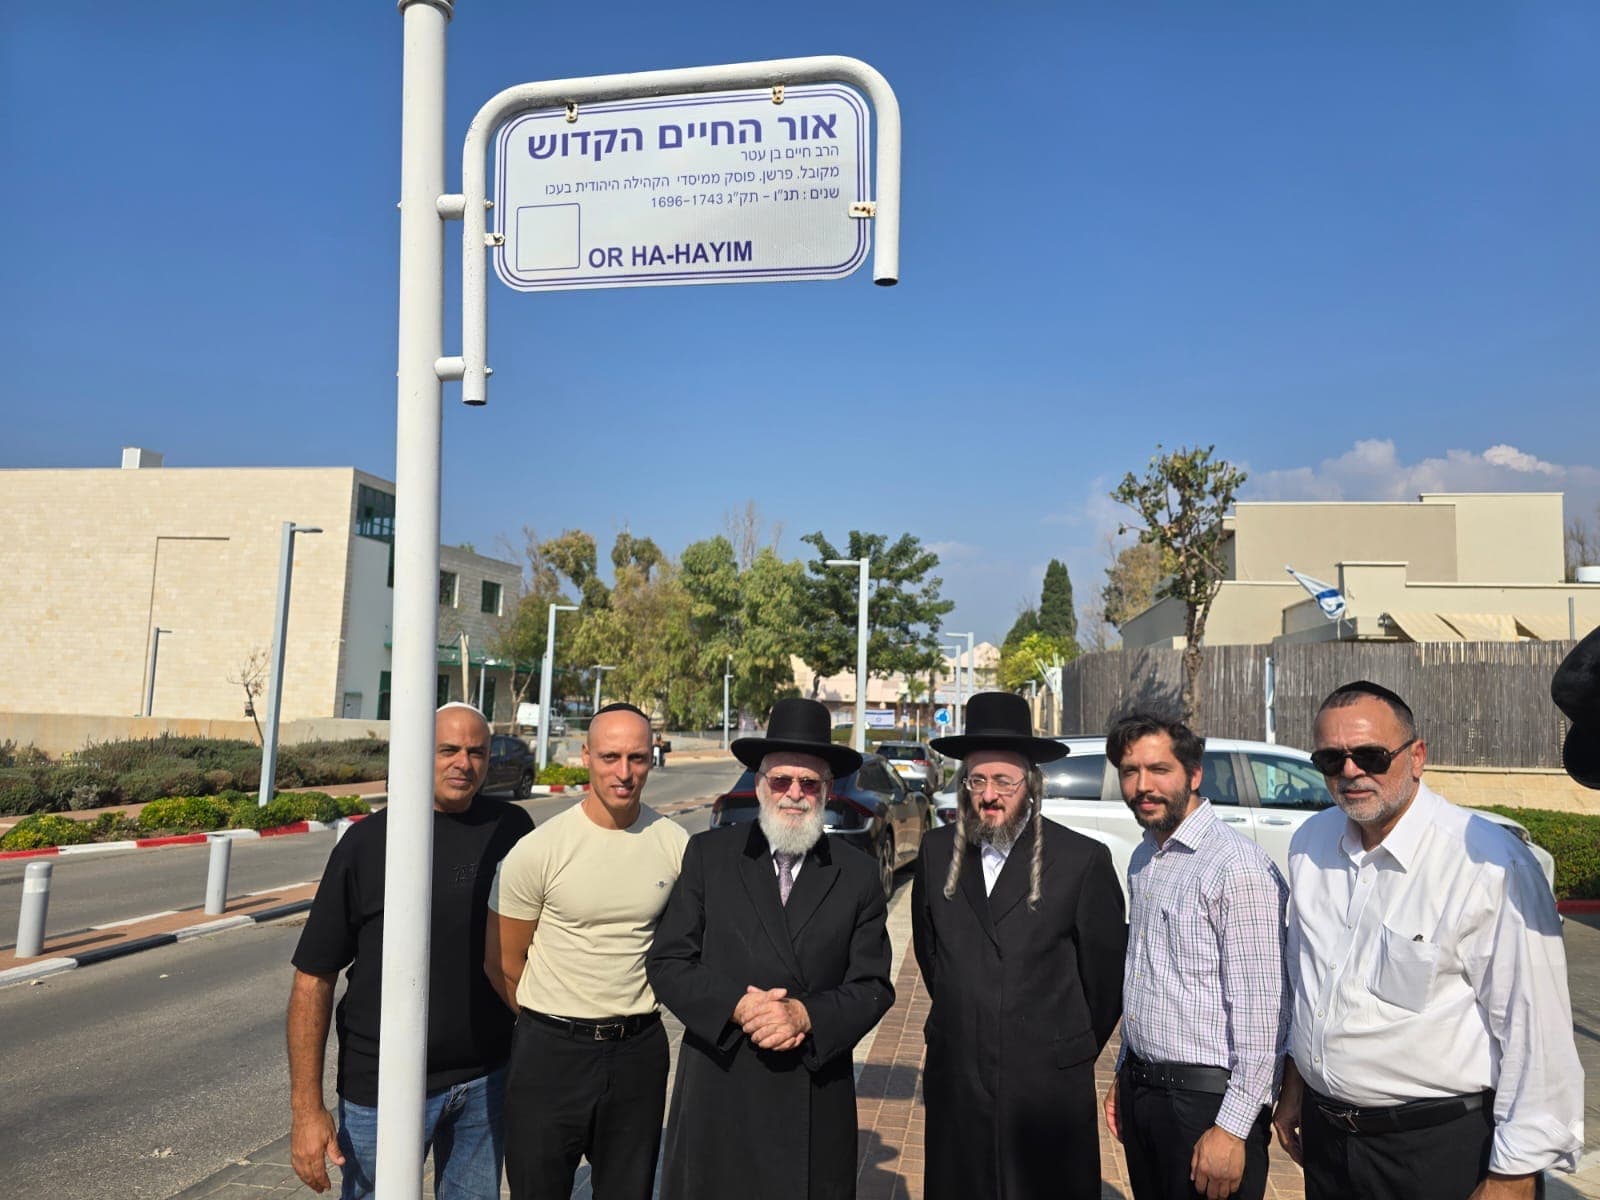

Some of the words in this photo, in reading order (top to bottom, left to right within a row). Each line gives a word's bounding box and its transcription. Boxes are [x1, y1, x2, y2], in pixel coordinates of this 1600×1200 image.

[659, 117, 762, 148] החיים
[777, 113, 837, 141] אור
[528, 128, 643, 162] הקדוש
[816, 146, 839, 157] הרב
[741, 151, 766, 162] עטר
[770, 149, 781, 163] בן
[786, 148, 811, 158] חיים
[624, 176, 669, 189] הקהילה
[677, 173, 720, 185] ממיסדי
[725, 172, 755, 186] פוסק
[546, 184, 571, 195] בעכו
[576, 180, 619, 192] היהודית
[588, 247, 624, 268] OR
[632, 240, 752, 267] HA-HAYIM
